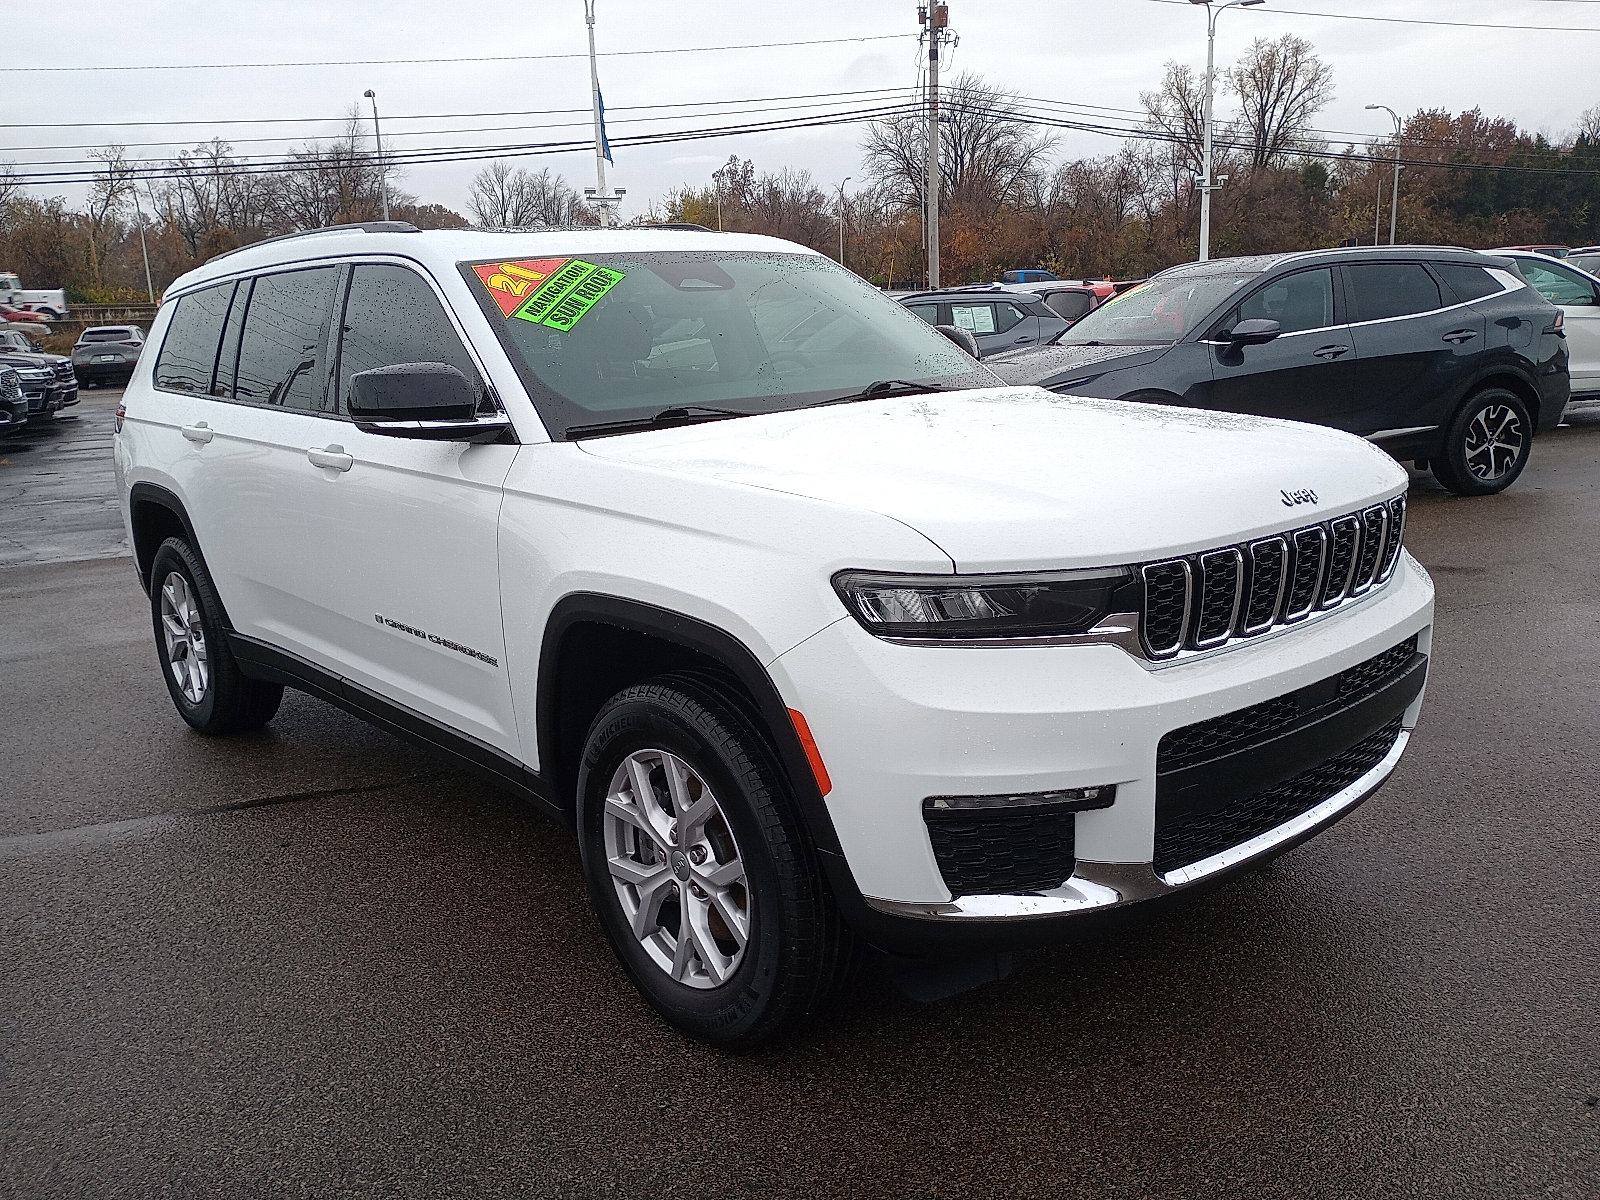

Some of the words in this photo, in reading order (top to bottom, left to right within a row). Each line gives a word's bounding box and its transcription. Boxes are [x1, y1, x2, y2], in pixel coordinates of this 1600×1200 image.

[487, 263, 547, 297] 21
[524, 264, 590, 317] NAVIGATION
[550, 296, 590, 326] SUN
[576, 270, 616, 301] ROOF
[1280, 488, 1319, 507] Jeep
[384, 617, 427, 640] GRAND
[428, 633, 499, 668] CHEROKEE
